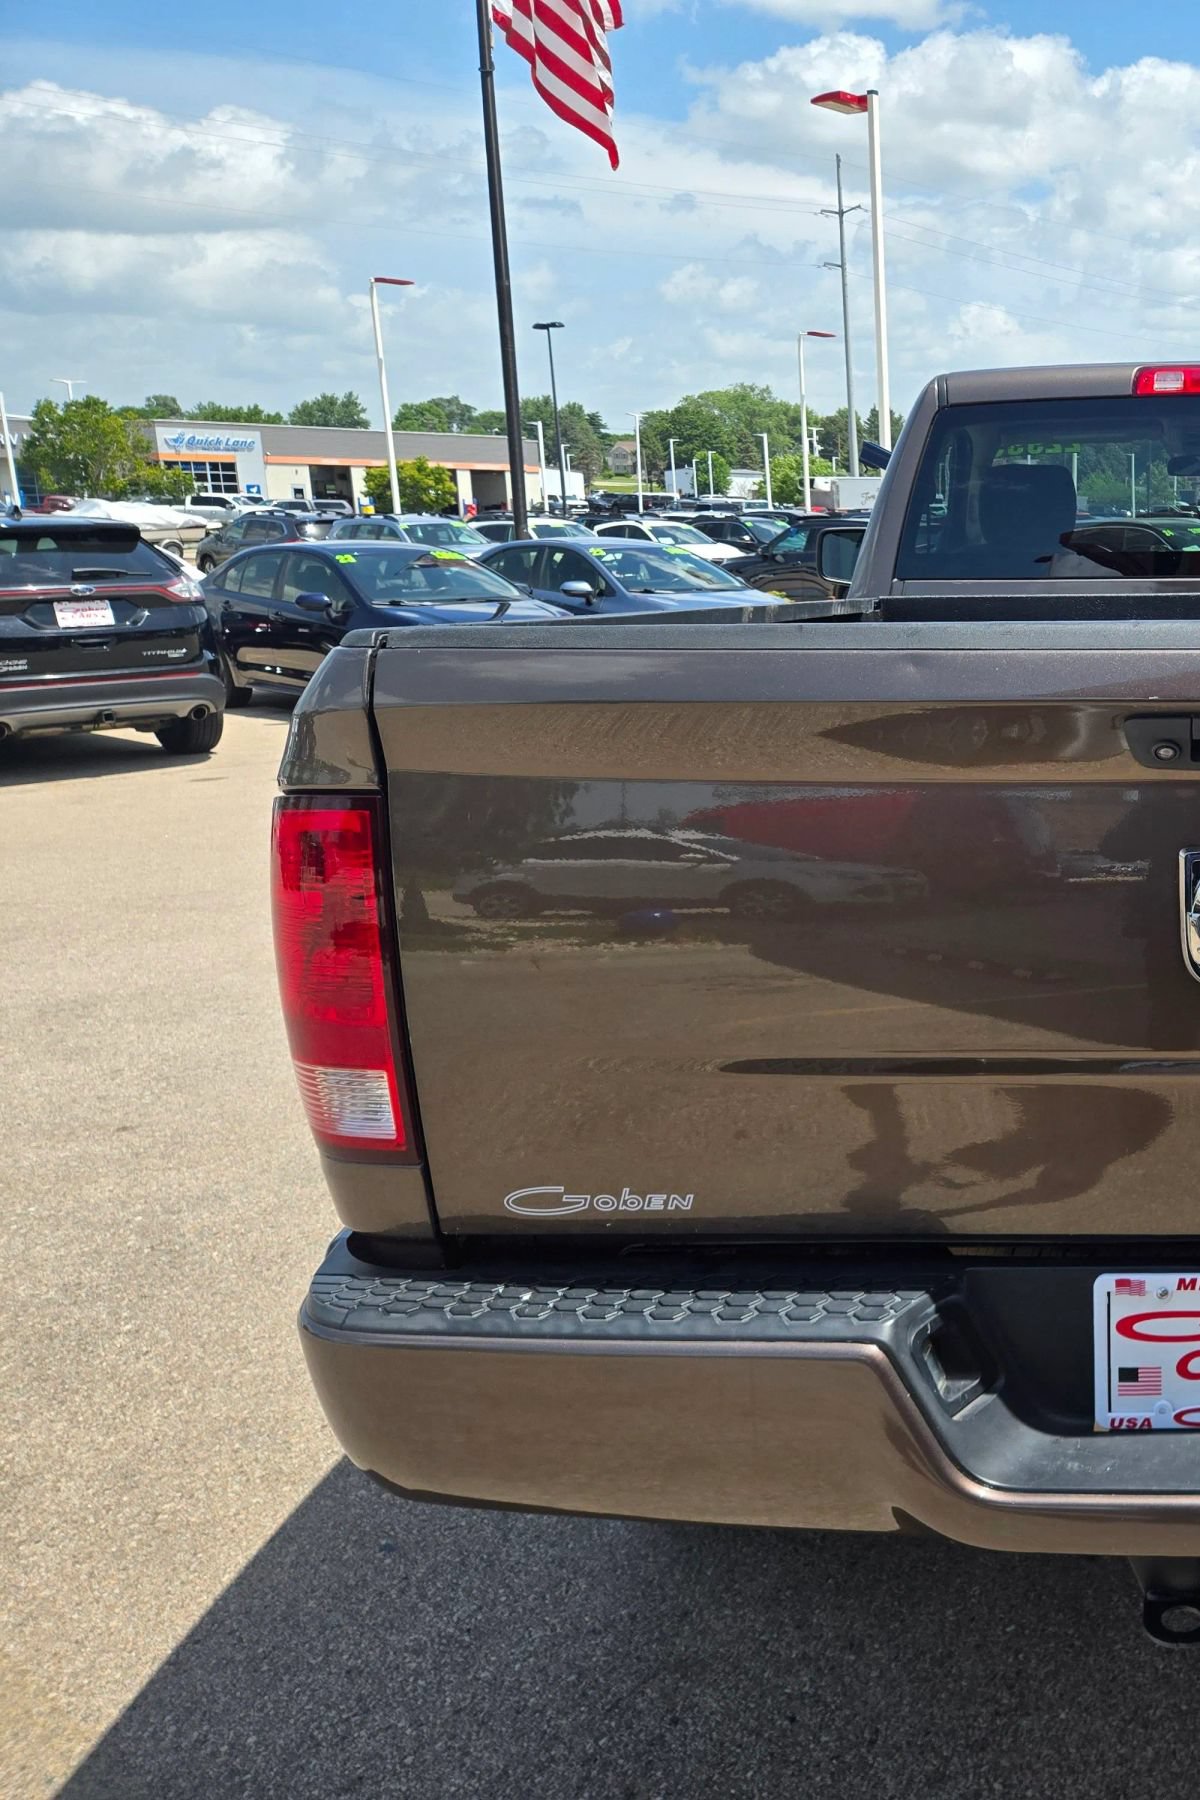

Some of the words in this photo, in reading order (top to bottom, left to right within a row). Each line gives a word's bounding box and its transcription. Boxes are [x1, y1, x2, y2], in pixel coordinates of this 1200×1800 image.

[187, 435, 223, 447] Quick
[225, 437, 255, 449] Lane
[1110, 1417, 1152, 1430] USA
